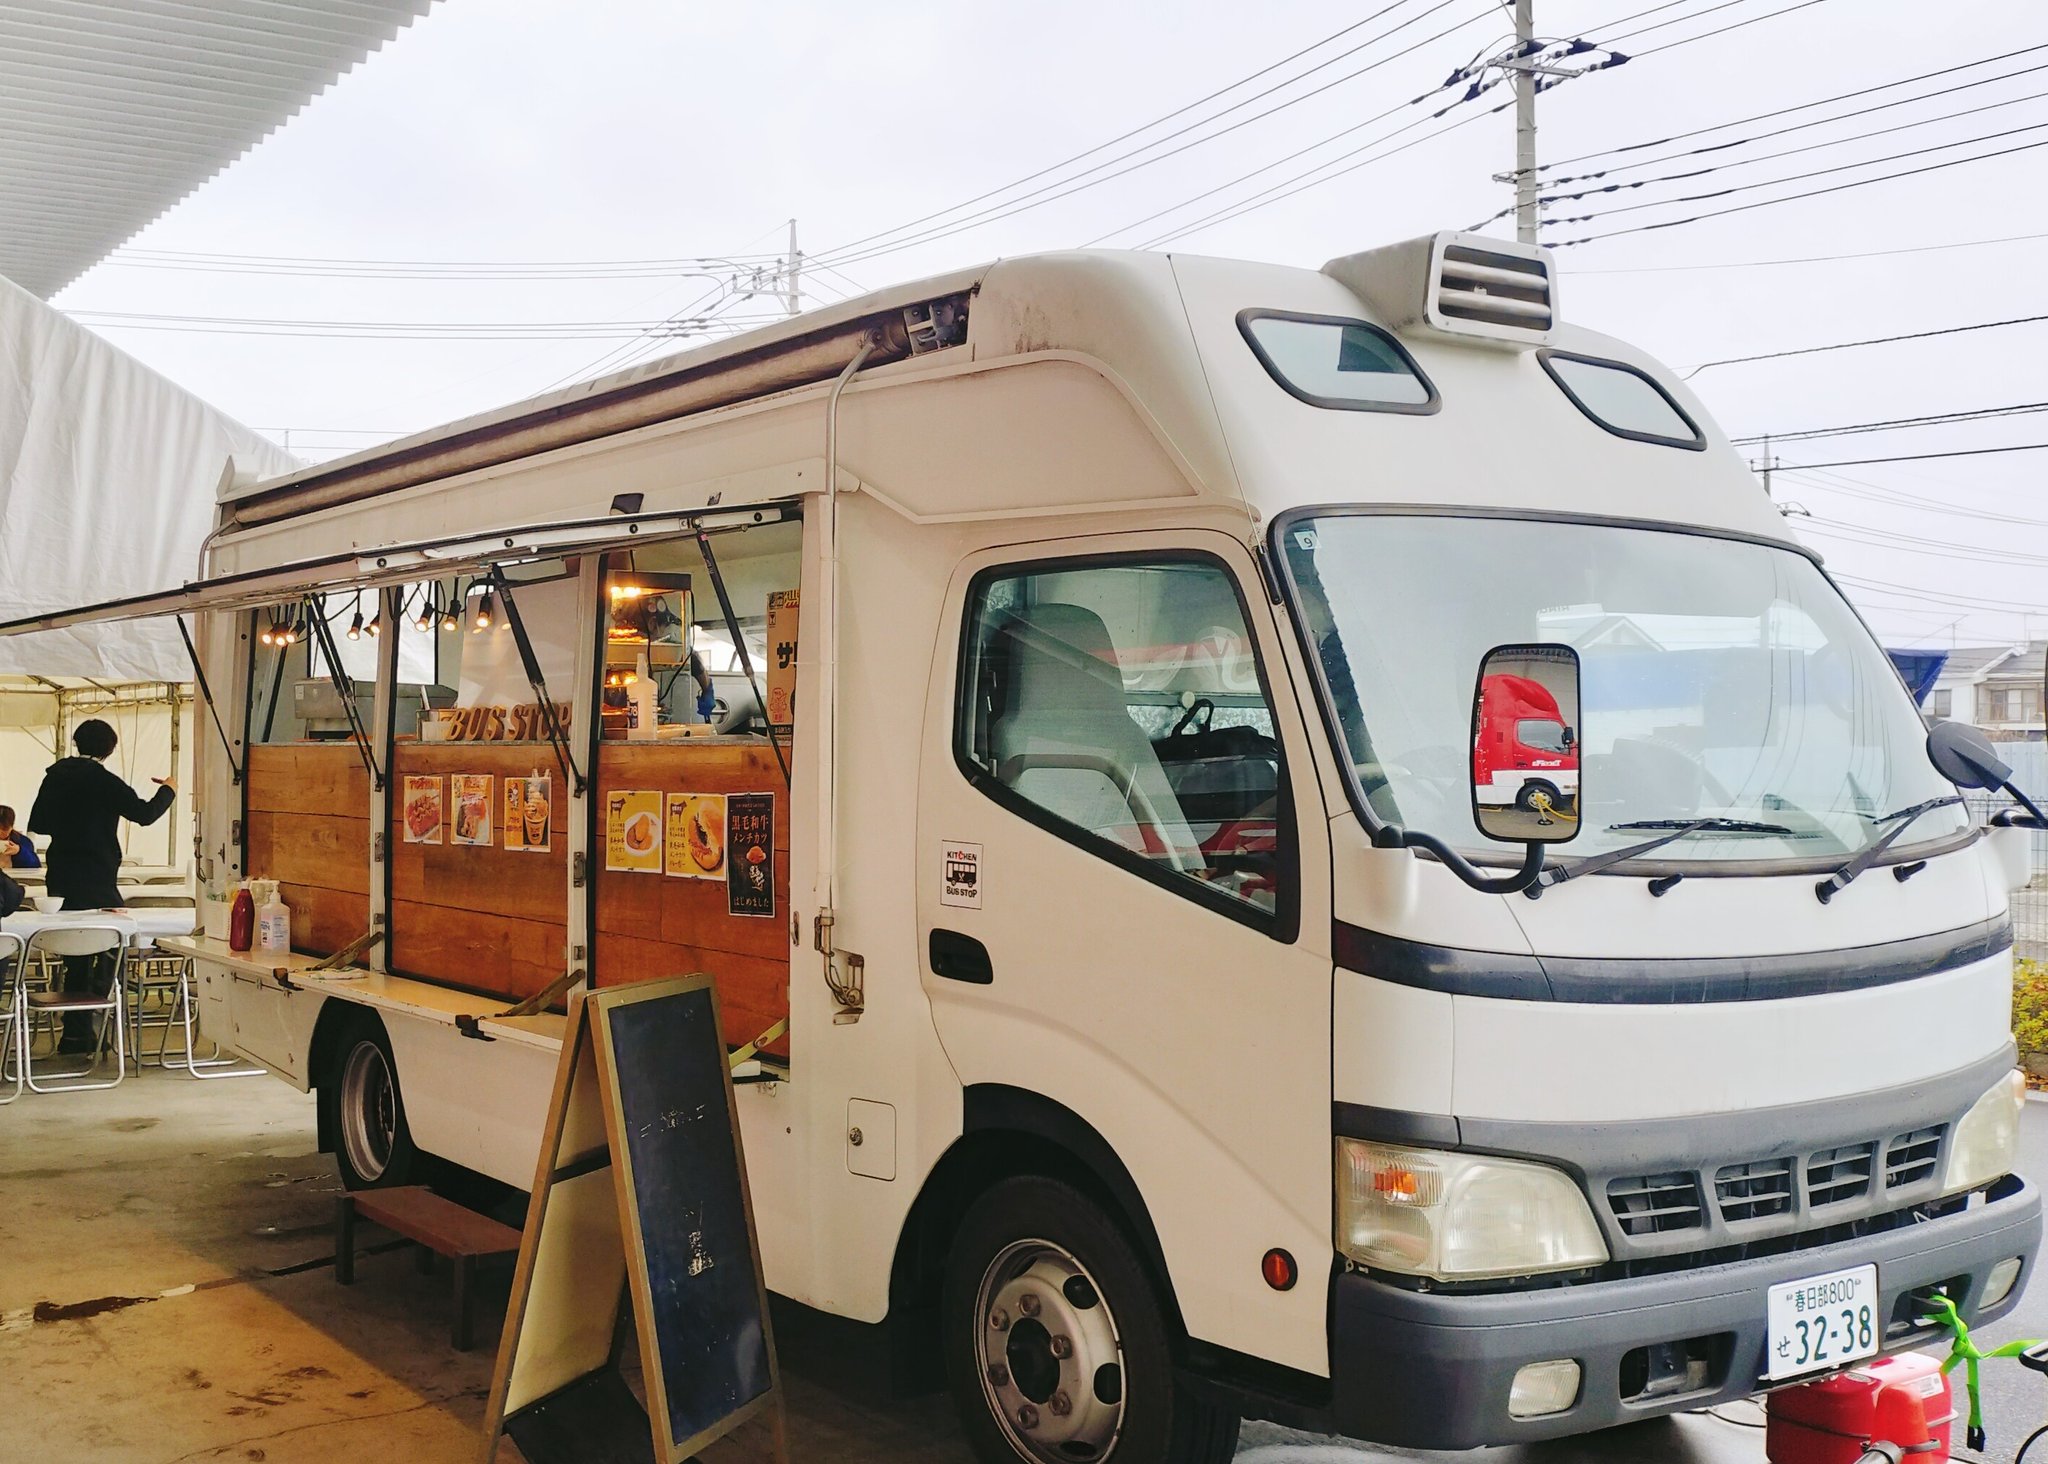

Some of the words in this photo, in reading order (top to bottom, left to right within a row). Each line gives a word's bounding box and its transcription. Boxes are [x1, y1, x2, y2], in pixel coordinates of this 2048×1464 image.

[1303, 537, 1313, 548] 9
[443, 705, 506, 740] BUS
[731, 814, 769, 831] 黒毛和牛
[733, 832, 768, 844] メンチカツ
[947, 850, 977, 861] KITCHEN
[946, 886, 960, 896] BUS
[960, 888, 977, 898] STOP
[733, 896, 769, 908] はじめました
[1795, 1305, 1871, 1365] 32-38
